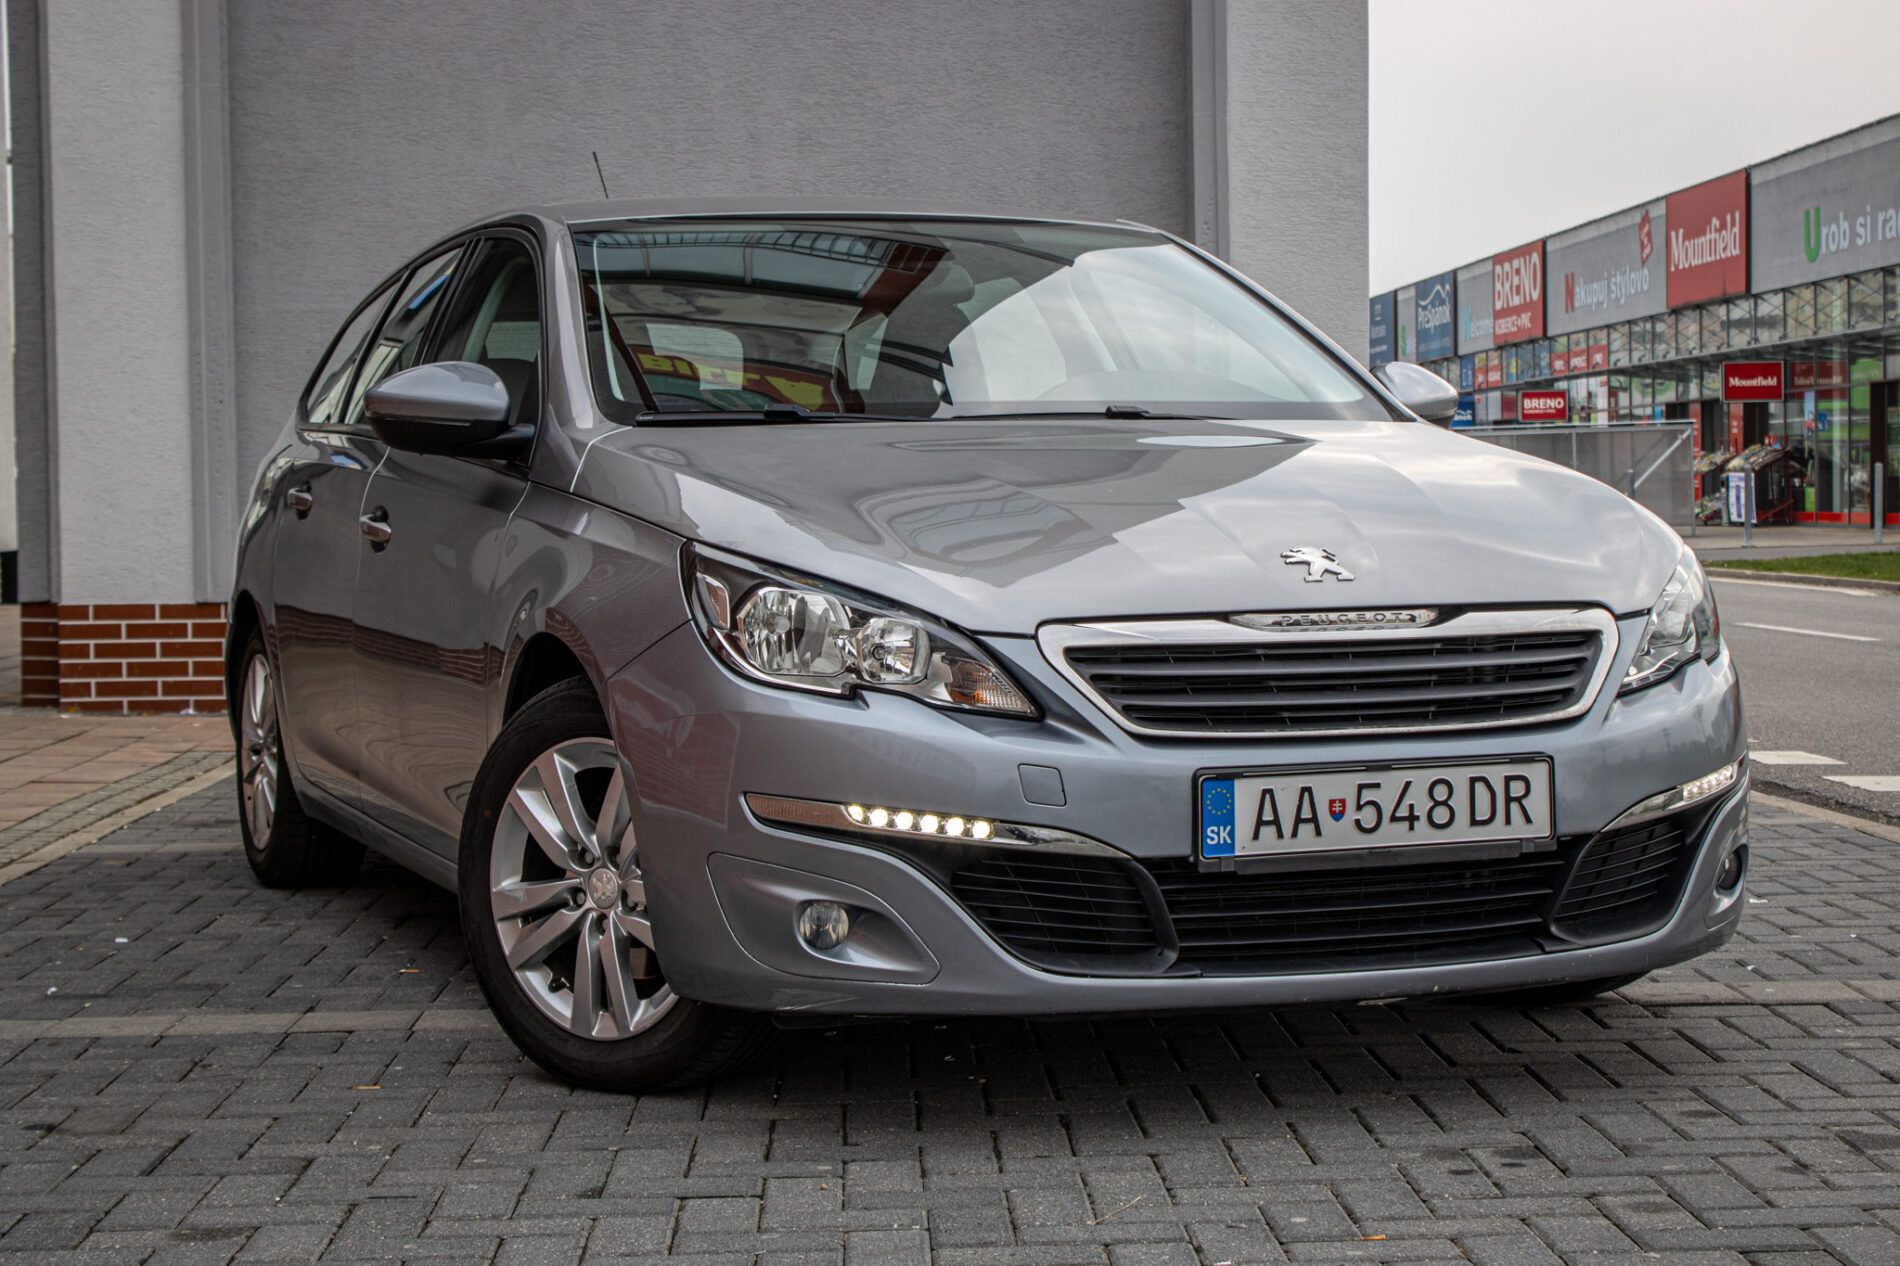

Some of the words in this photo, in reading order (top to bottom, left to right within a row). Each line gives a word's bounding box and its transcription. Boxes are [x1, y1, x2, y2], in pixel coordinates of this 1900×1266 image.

[1670, 210, 1741, 272] Mountfield
[1804, 207, 1850, 263] Urob
[1856, 204, 1871, 247] si
[1878, 207, 1900, 242] ra
[1494, 251, 1541, 311] BRENO
[1565, 271, 1607, 314] Nakupuj
[1610, 265, 1650, 304] štýlovo
[1523, 397, 1564, 409] BRENO
[1729, 376, 1777, 387] Mountfield
[1281, 612, 1403, 626] PEUGEOT
[1206, 825, 1232, 845] SK
[1252, 785, 1322, 841] AA
